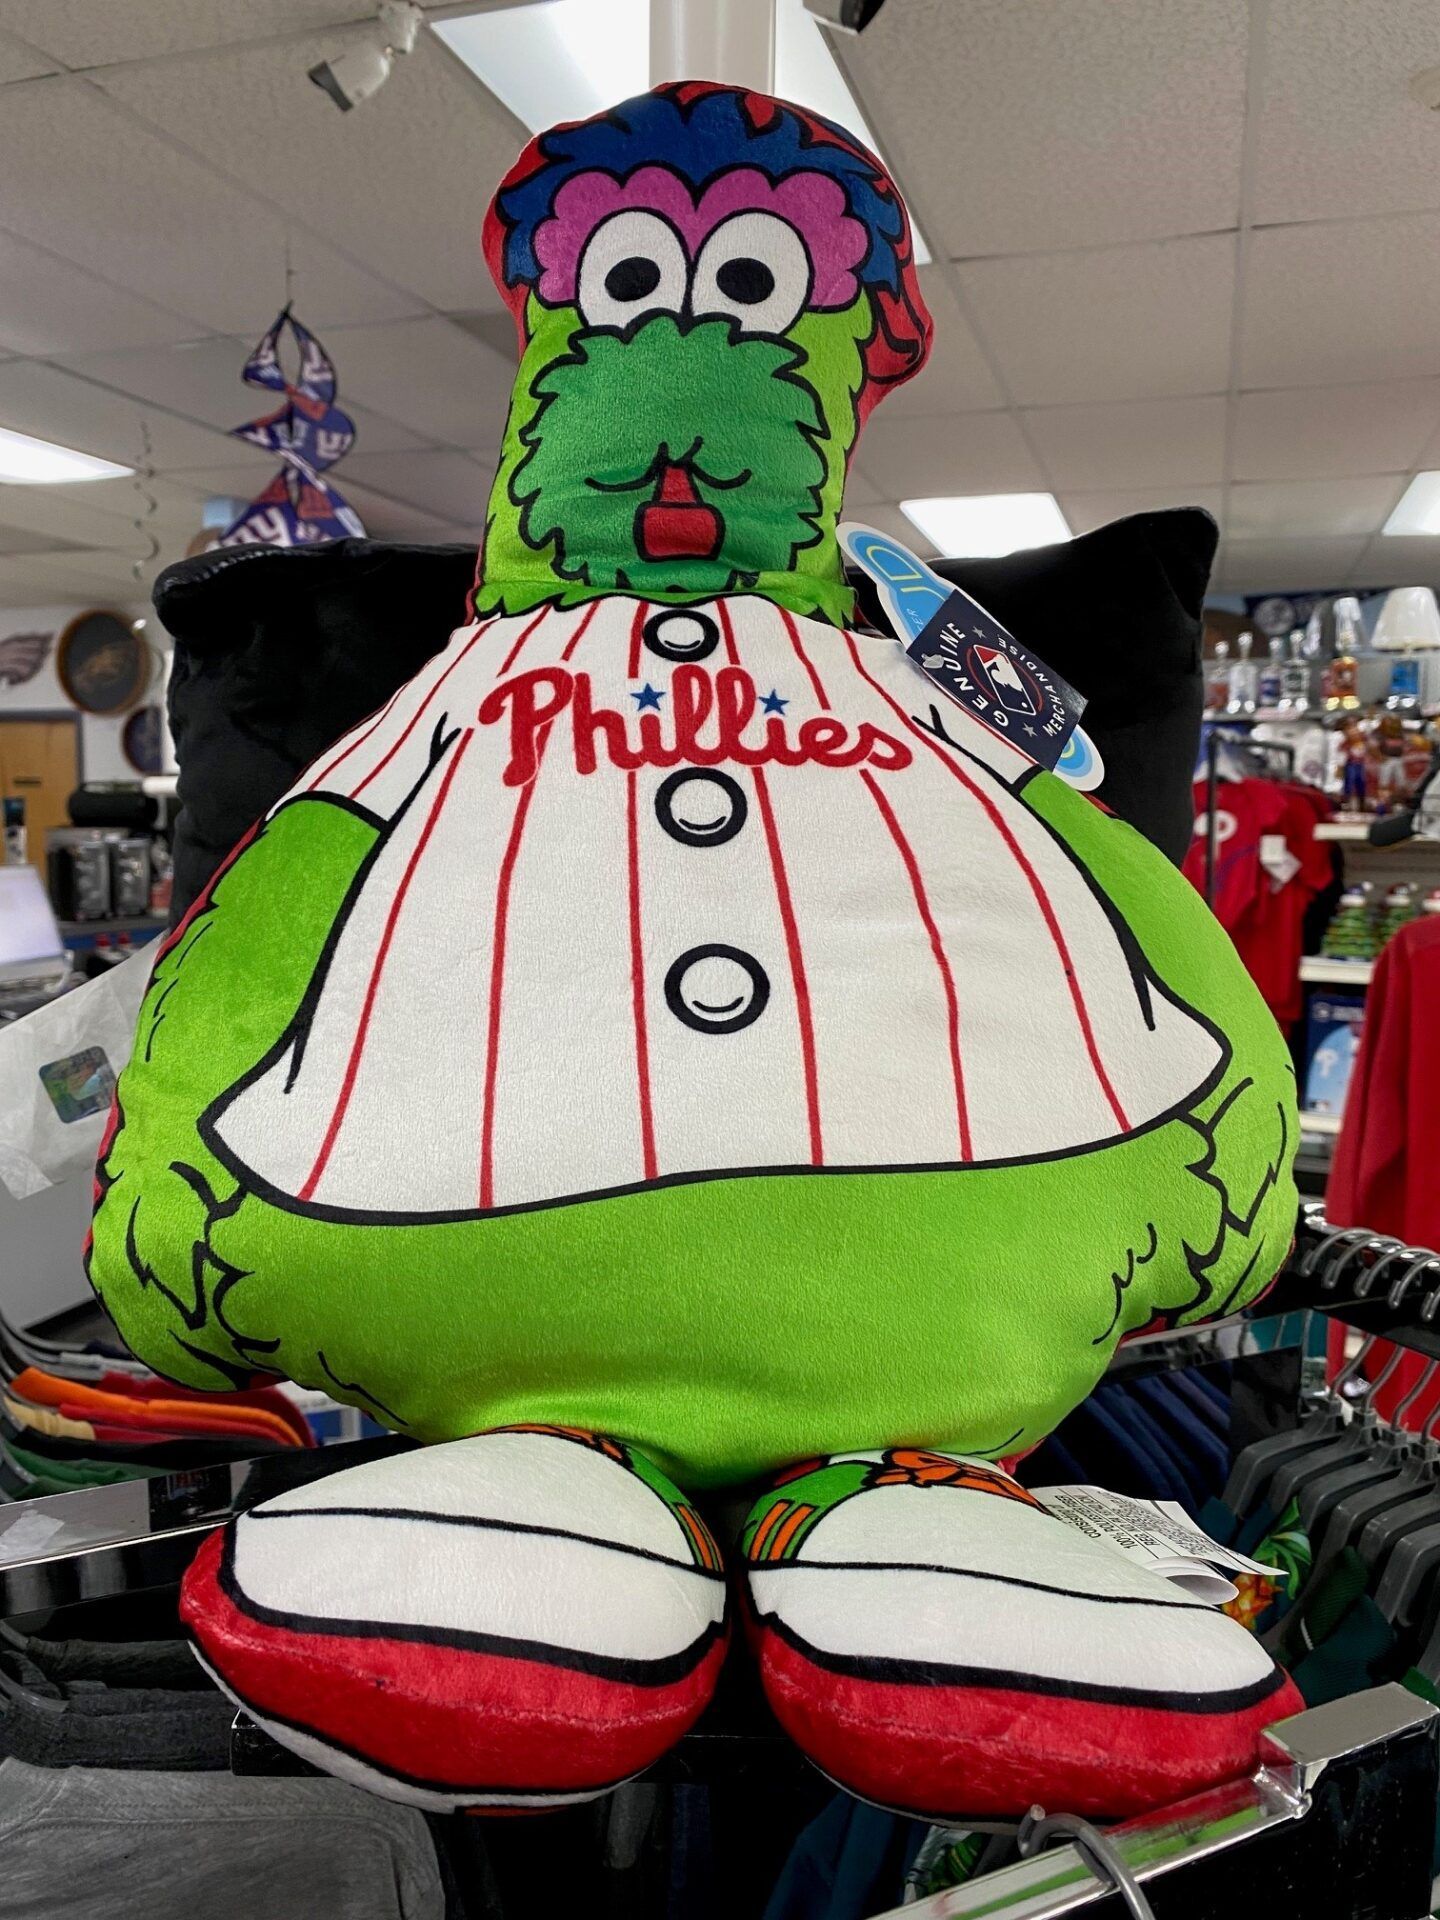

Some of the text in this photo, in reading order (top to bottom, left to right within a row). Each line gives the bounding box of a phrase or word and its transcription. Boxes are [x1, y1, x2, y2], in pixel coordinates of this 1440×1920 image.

[478, 664, 914, 787] Phillies
[940, 622, 1009, 727] GENUINE
[997, 636, 1066, 737] MERCHANDISE
[1109, 1531, 1138, 1549] 100%
